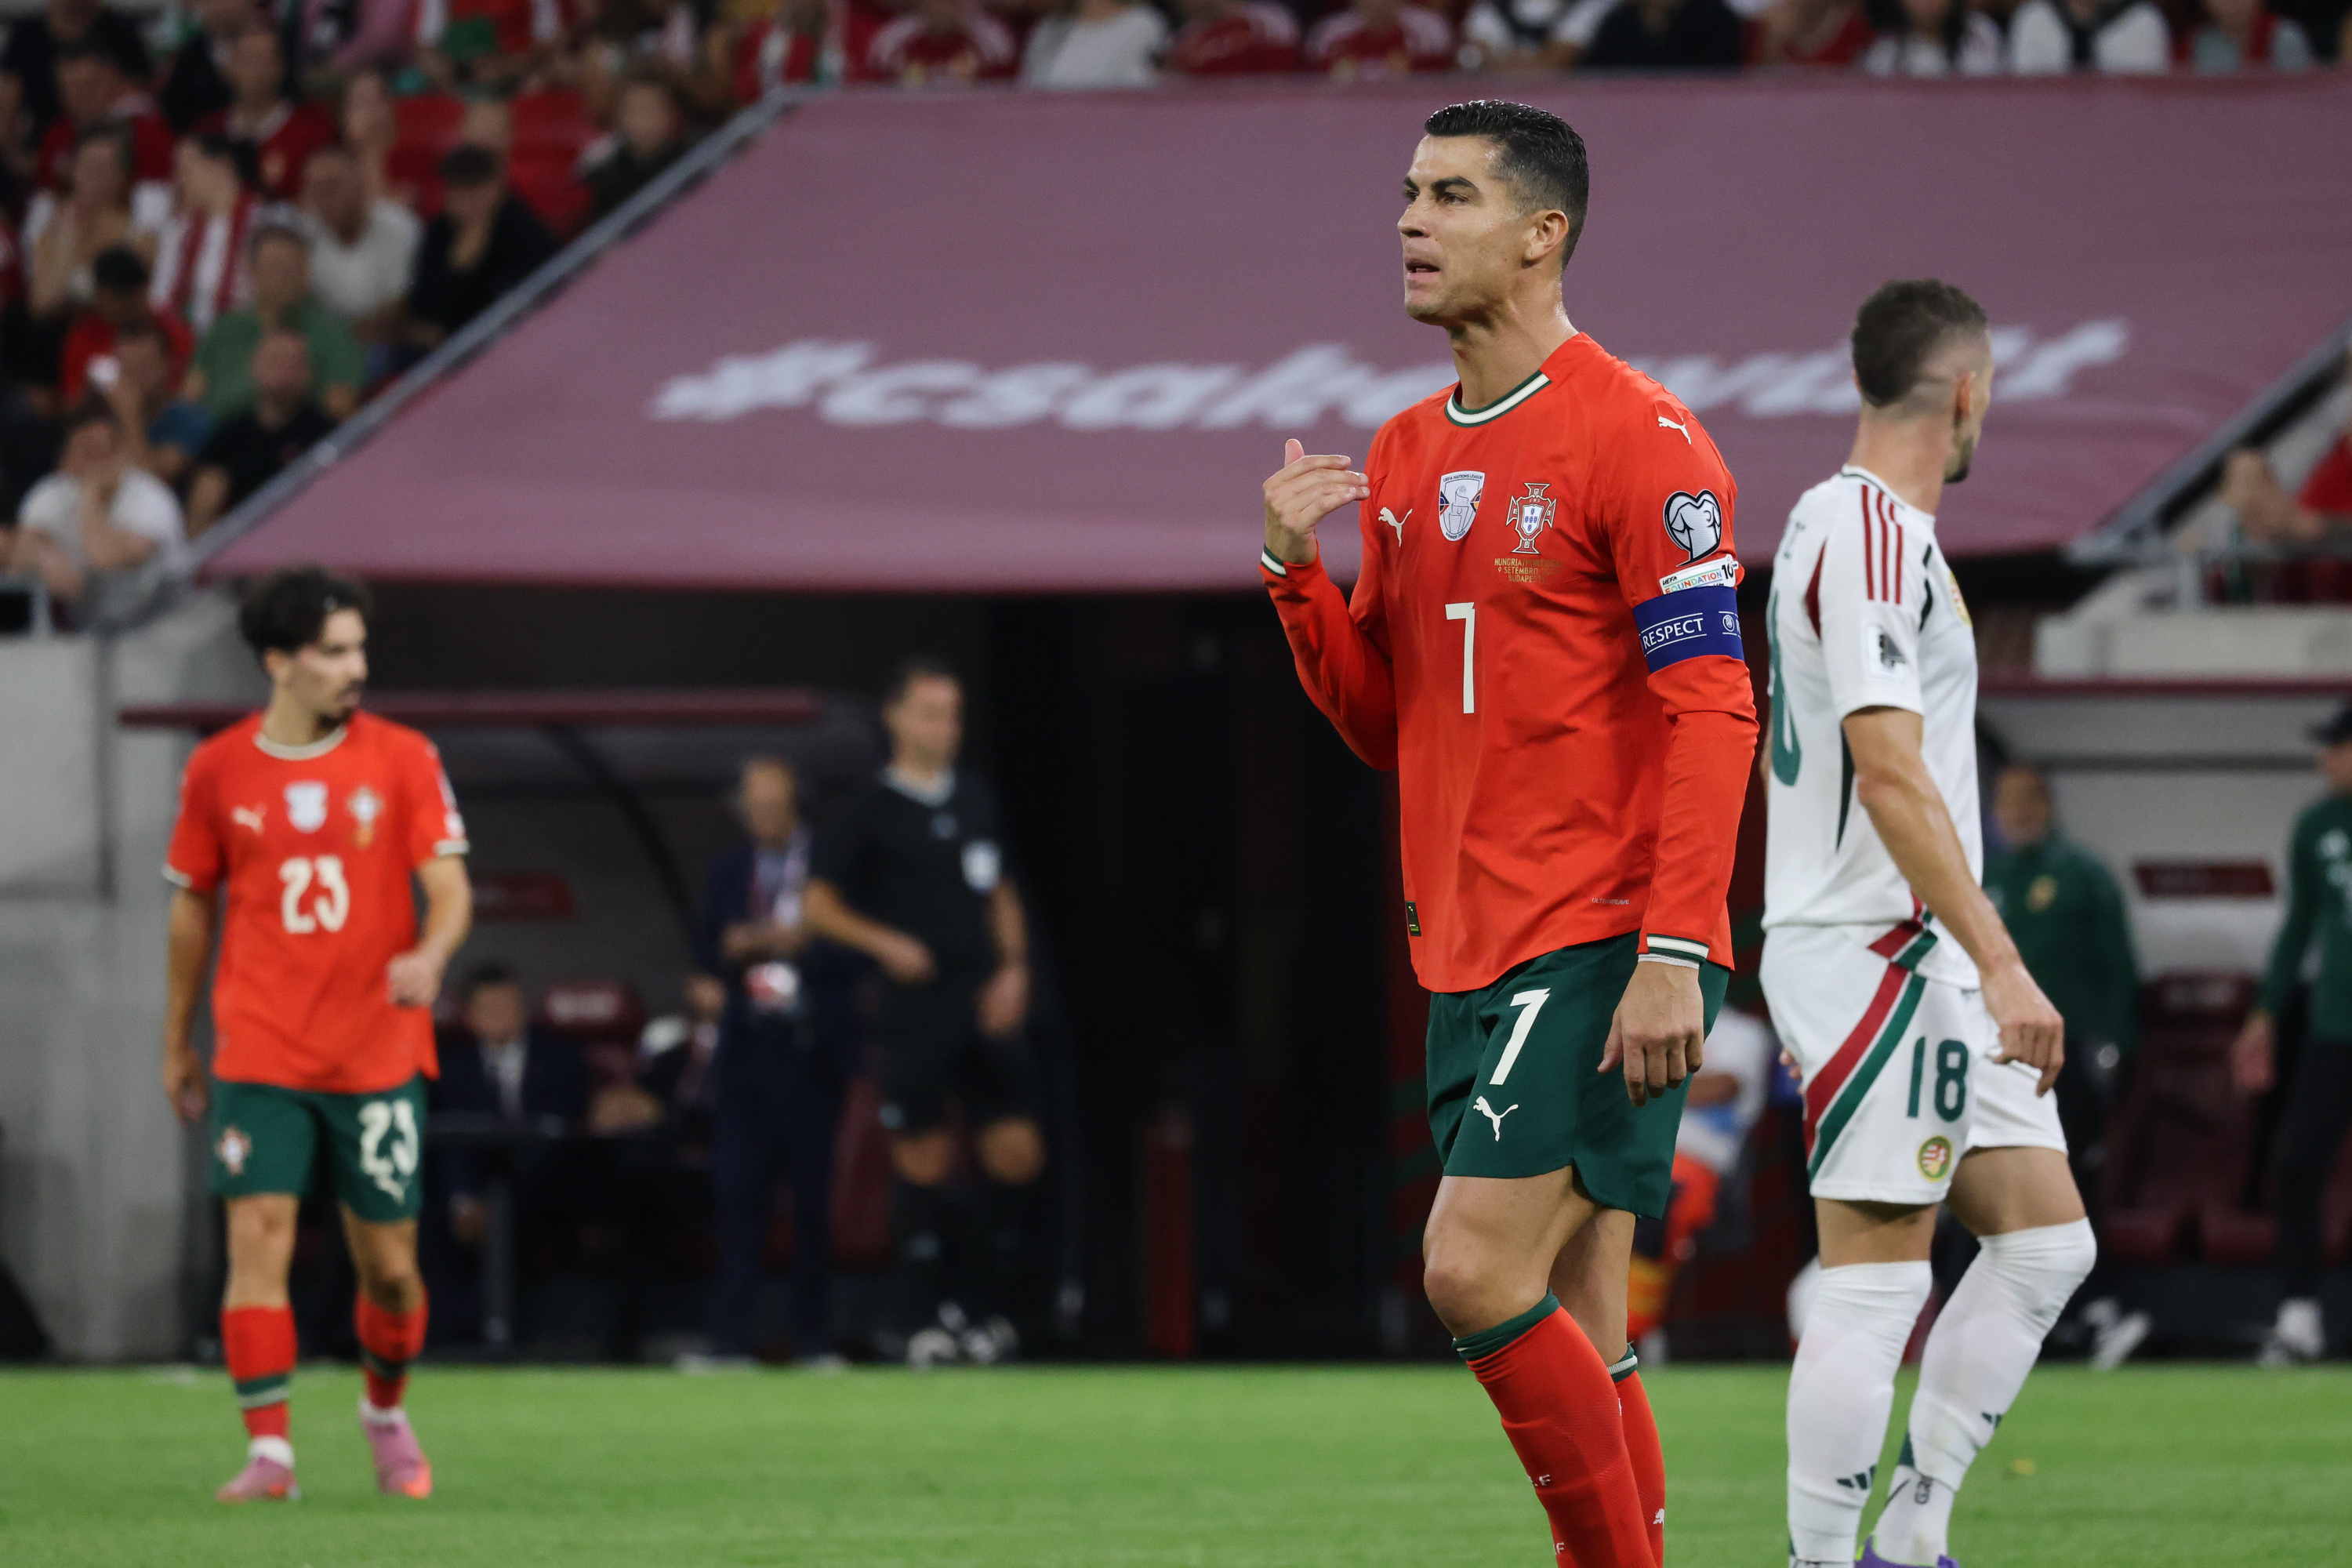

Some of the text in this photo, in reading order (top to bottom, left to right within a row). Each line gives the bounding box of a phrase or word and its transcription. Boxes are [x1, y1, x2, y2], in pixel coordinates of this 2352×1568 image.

[1504, 566, 1539, 575] SETEMBRO
[1662, 575, 1678, 586] UEFA
[1665, 571, 1722, 594] FOUNDATION
[1445, 601, 1475, 714] 7
[1642, 618, 1704, 650] RESPECT
[279, 855, 350, 935] 23
[1489, 987, 1551, 1085] 7
[1906, 1036, 1969, 1123] 18
[358, 1100, 419, 1175] 23
